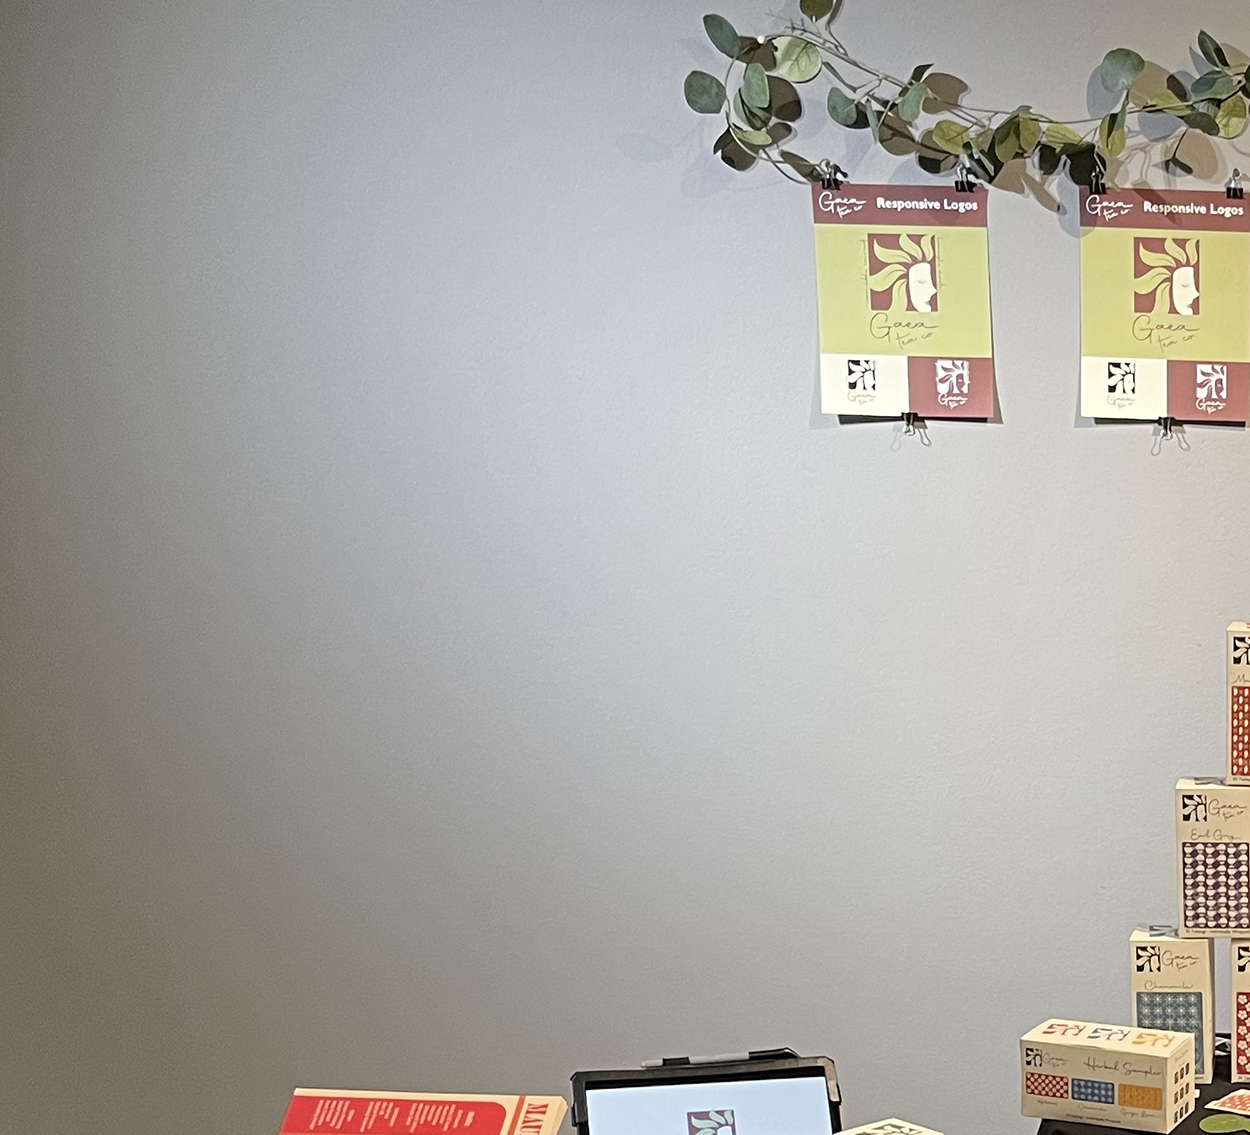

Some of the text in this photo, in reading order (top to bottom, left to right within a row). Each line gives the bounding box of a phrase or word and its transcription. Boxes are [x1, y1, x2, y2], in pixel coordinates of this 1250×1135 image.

[876, 197, 978, 213] Responsive Logos
[1143, 201, 1244, 218] Responsive Logos
[870, 312, 940, 343] Gaea
[1132, 314, 1200, 345] Gaea
